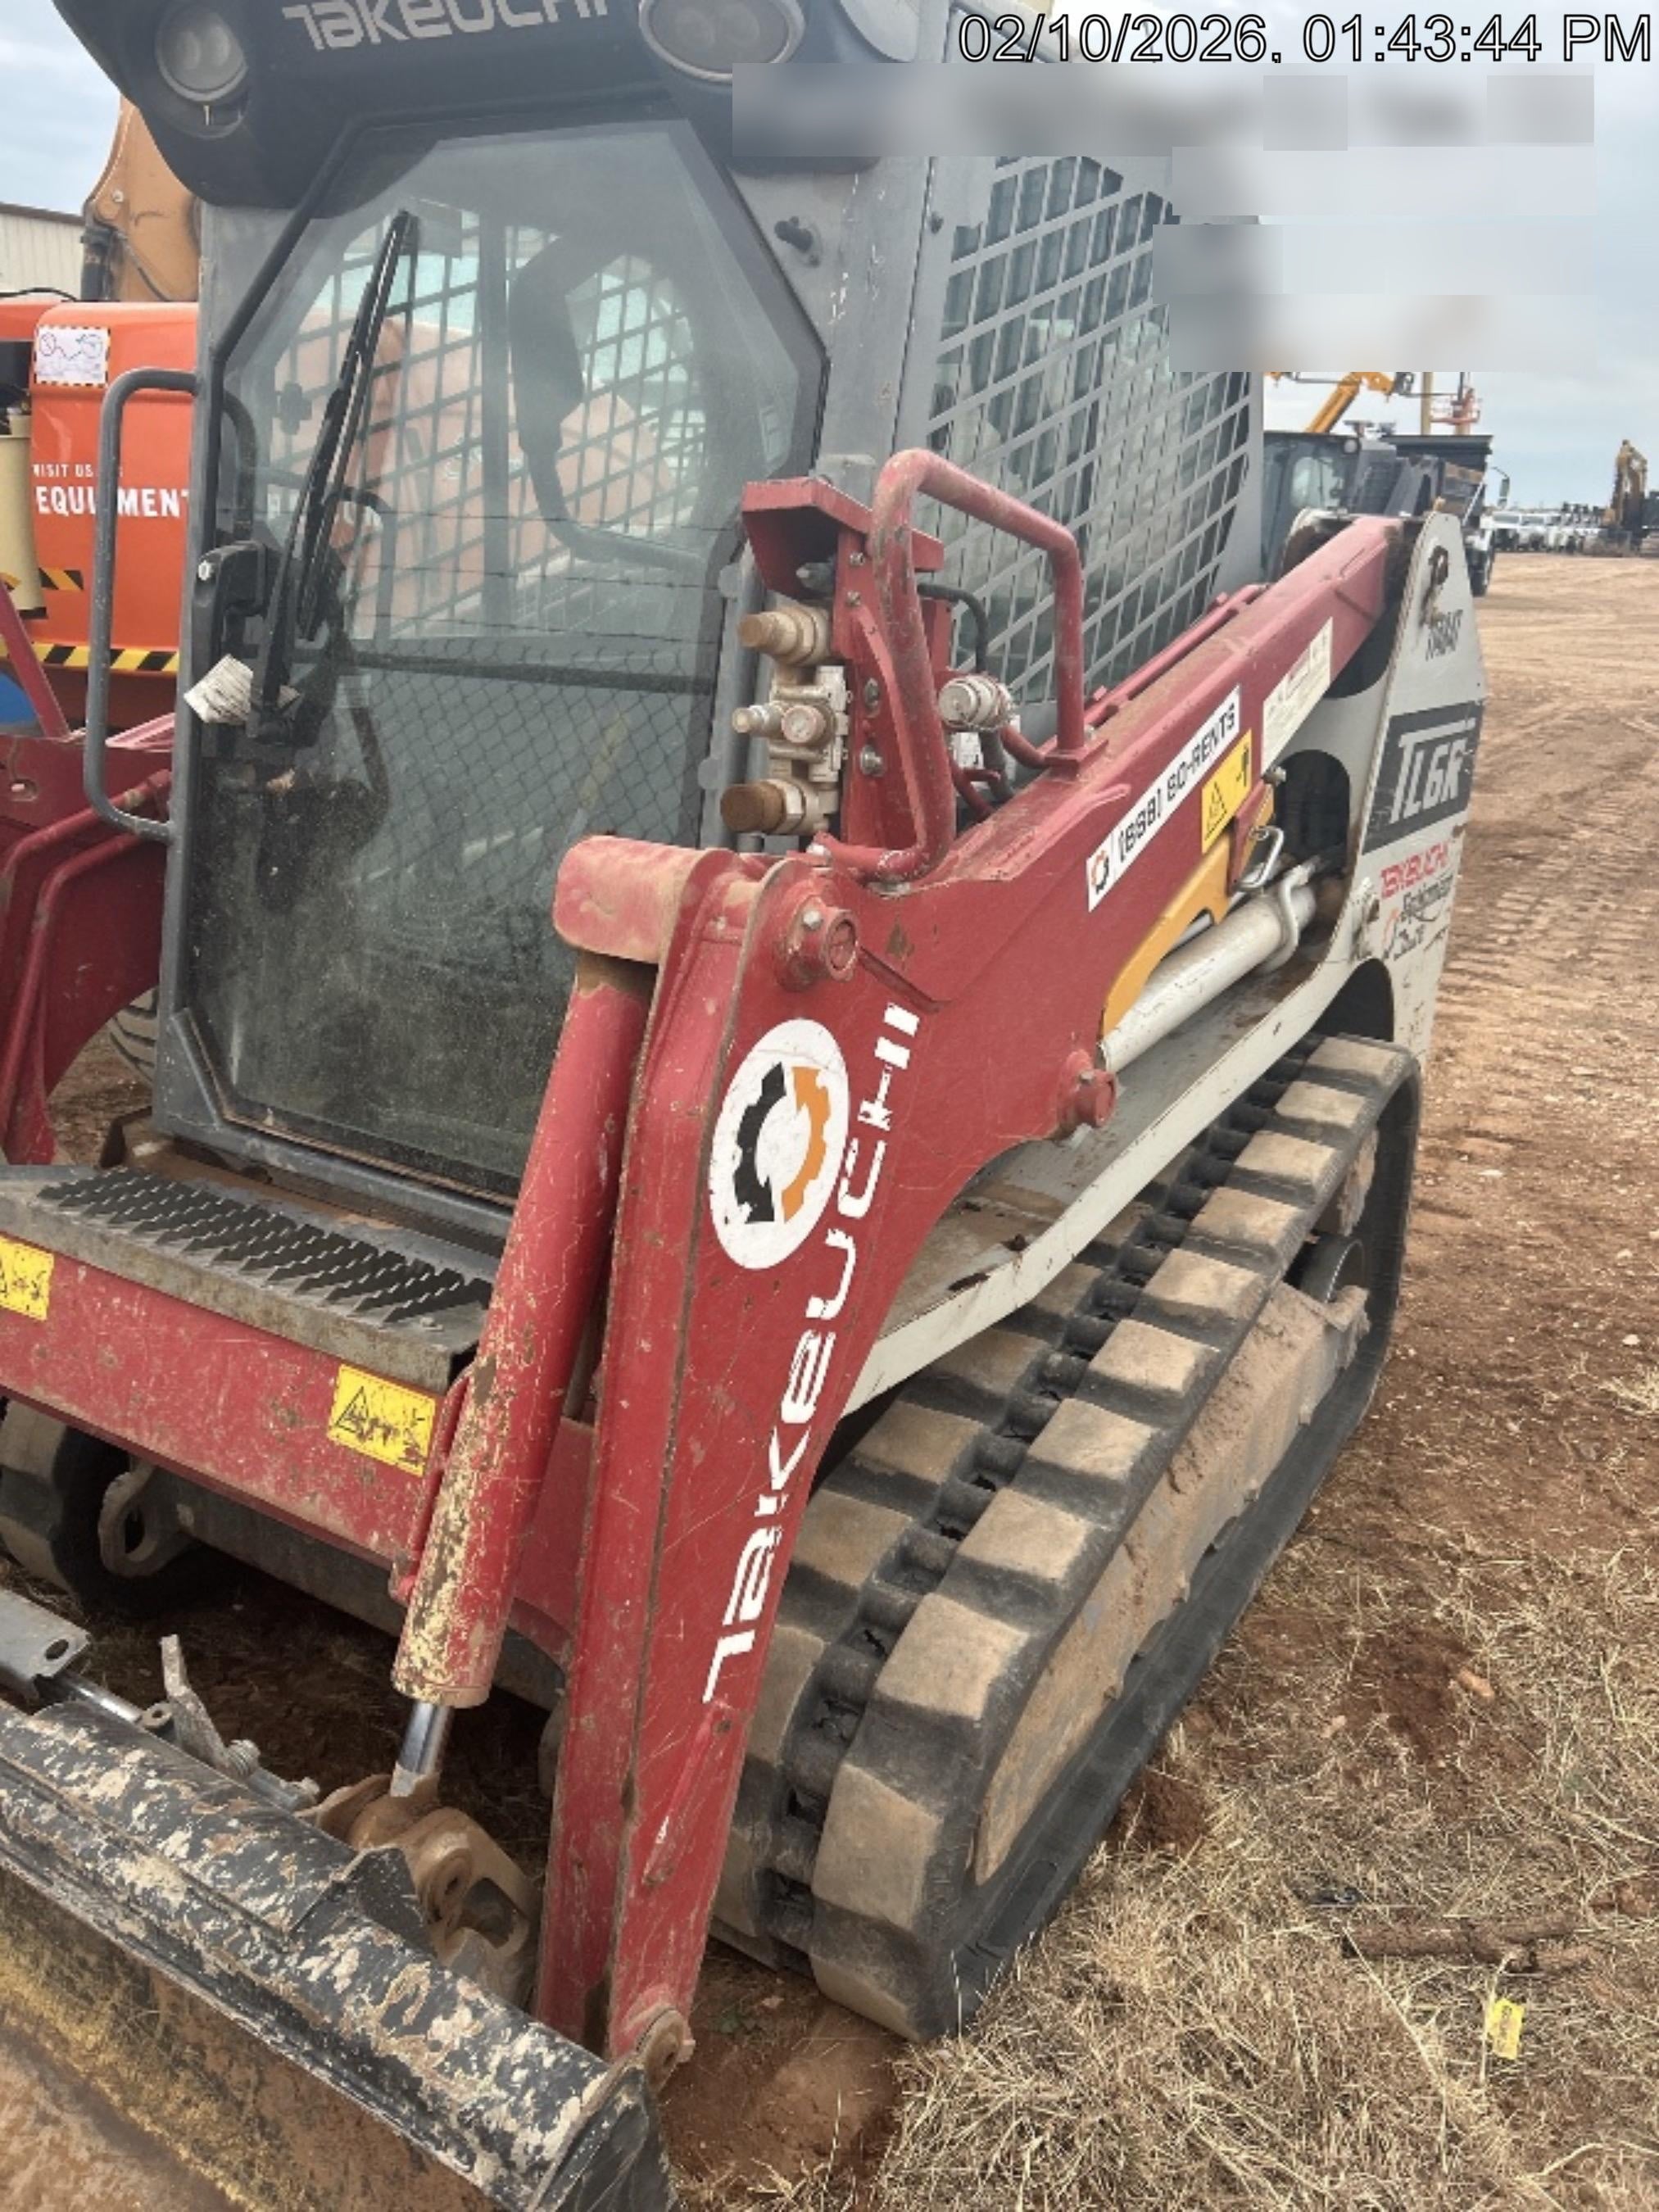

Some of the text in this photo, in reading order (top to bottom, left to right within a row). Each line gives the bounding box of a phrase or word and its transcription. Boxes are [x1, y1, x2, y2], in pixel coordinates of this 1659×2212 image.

[75, 464, 93, 478] US
[35, 486, 189, 517] EQUIMEN
[1389, 718, 1475, 824] TL6R
